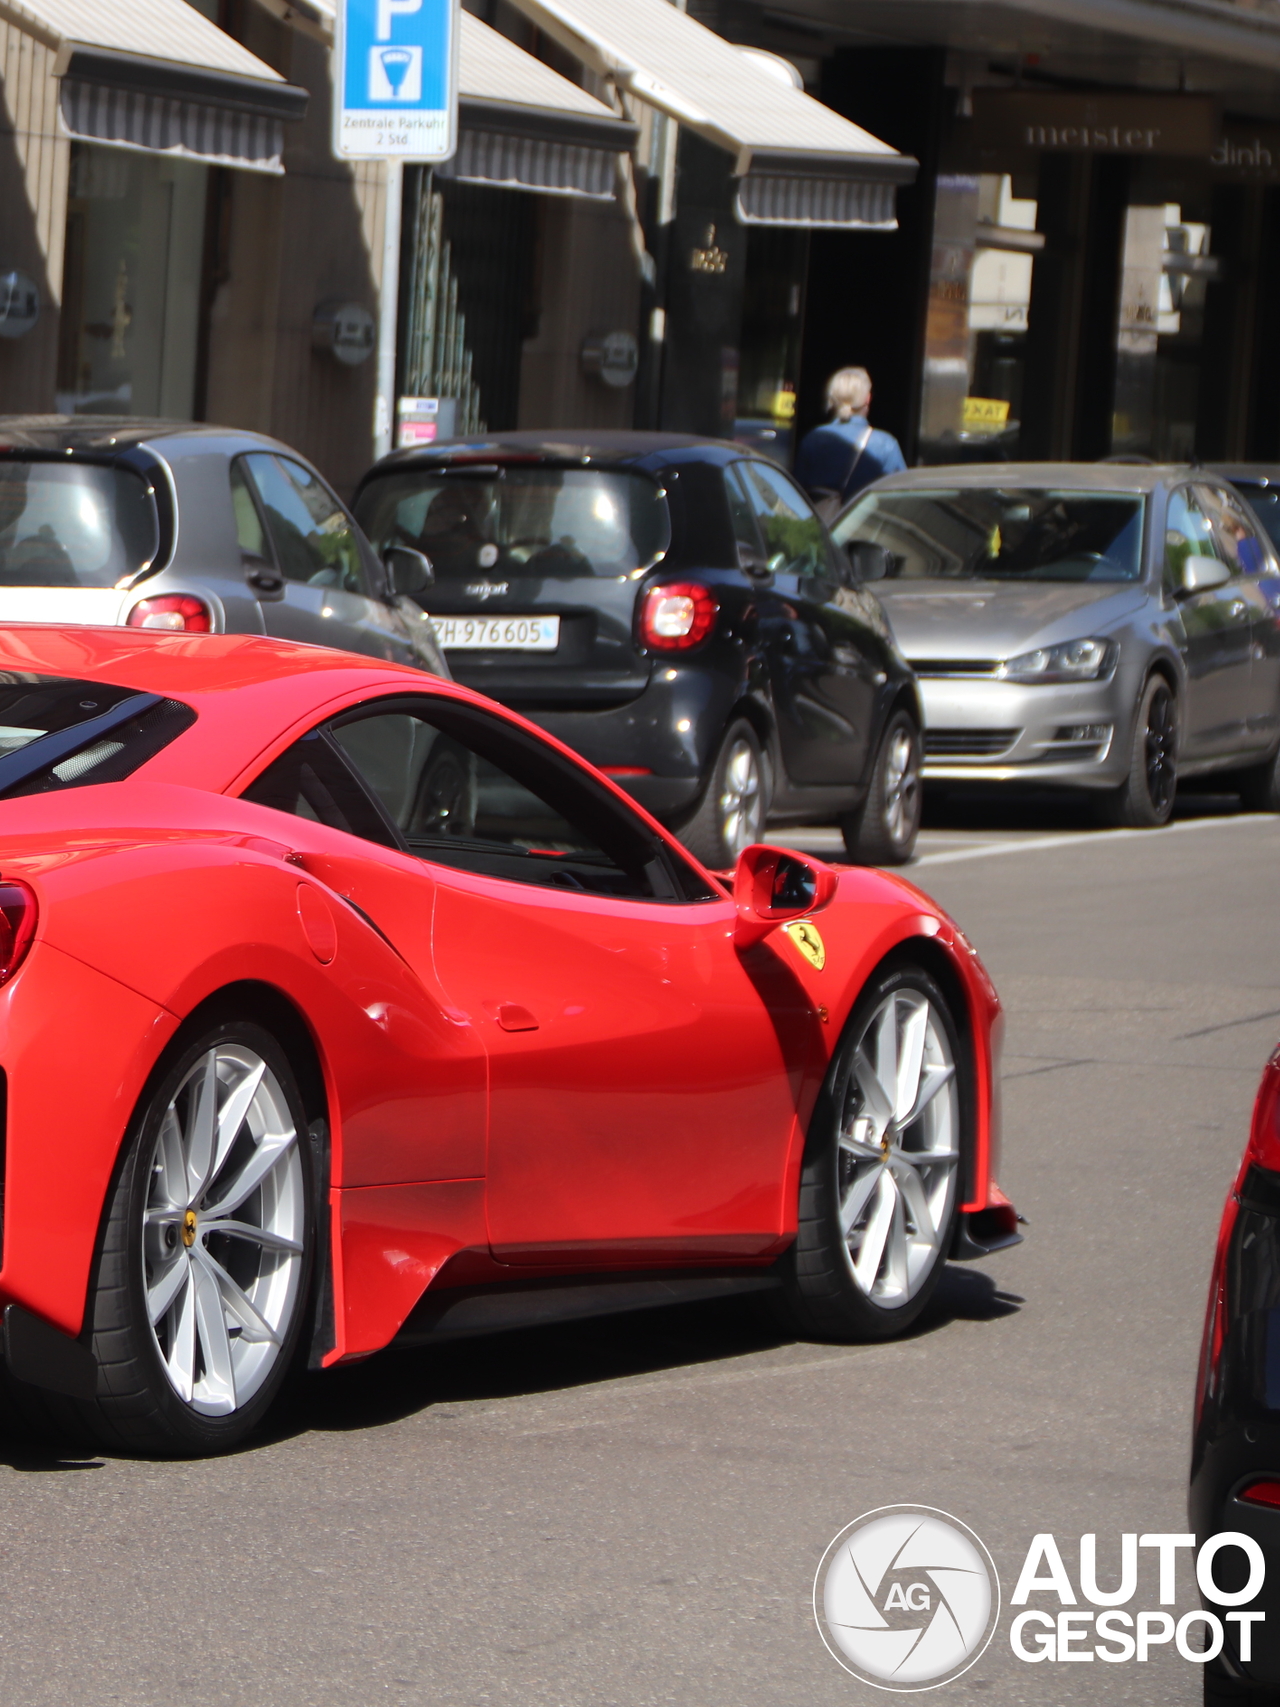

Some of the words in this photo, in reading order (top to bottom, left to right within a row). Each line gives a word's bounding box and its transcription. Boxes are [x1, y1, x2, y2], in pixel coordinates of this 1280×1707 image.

[377, 0, 422, 41] P
[344, 115, 394, 129] Zentrale
[399, 116, 445, 129] Parkuhr
[376, 132, 384, 146] 2
[1024, 125, 1161, 149] meister
[1210, 138, 1272, 167] dinh
